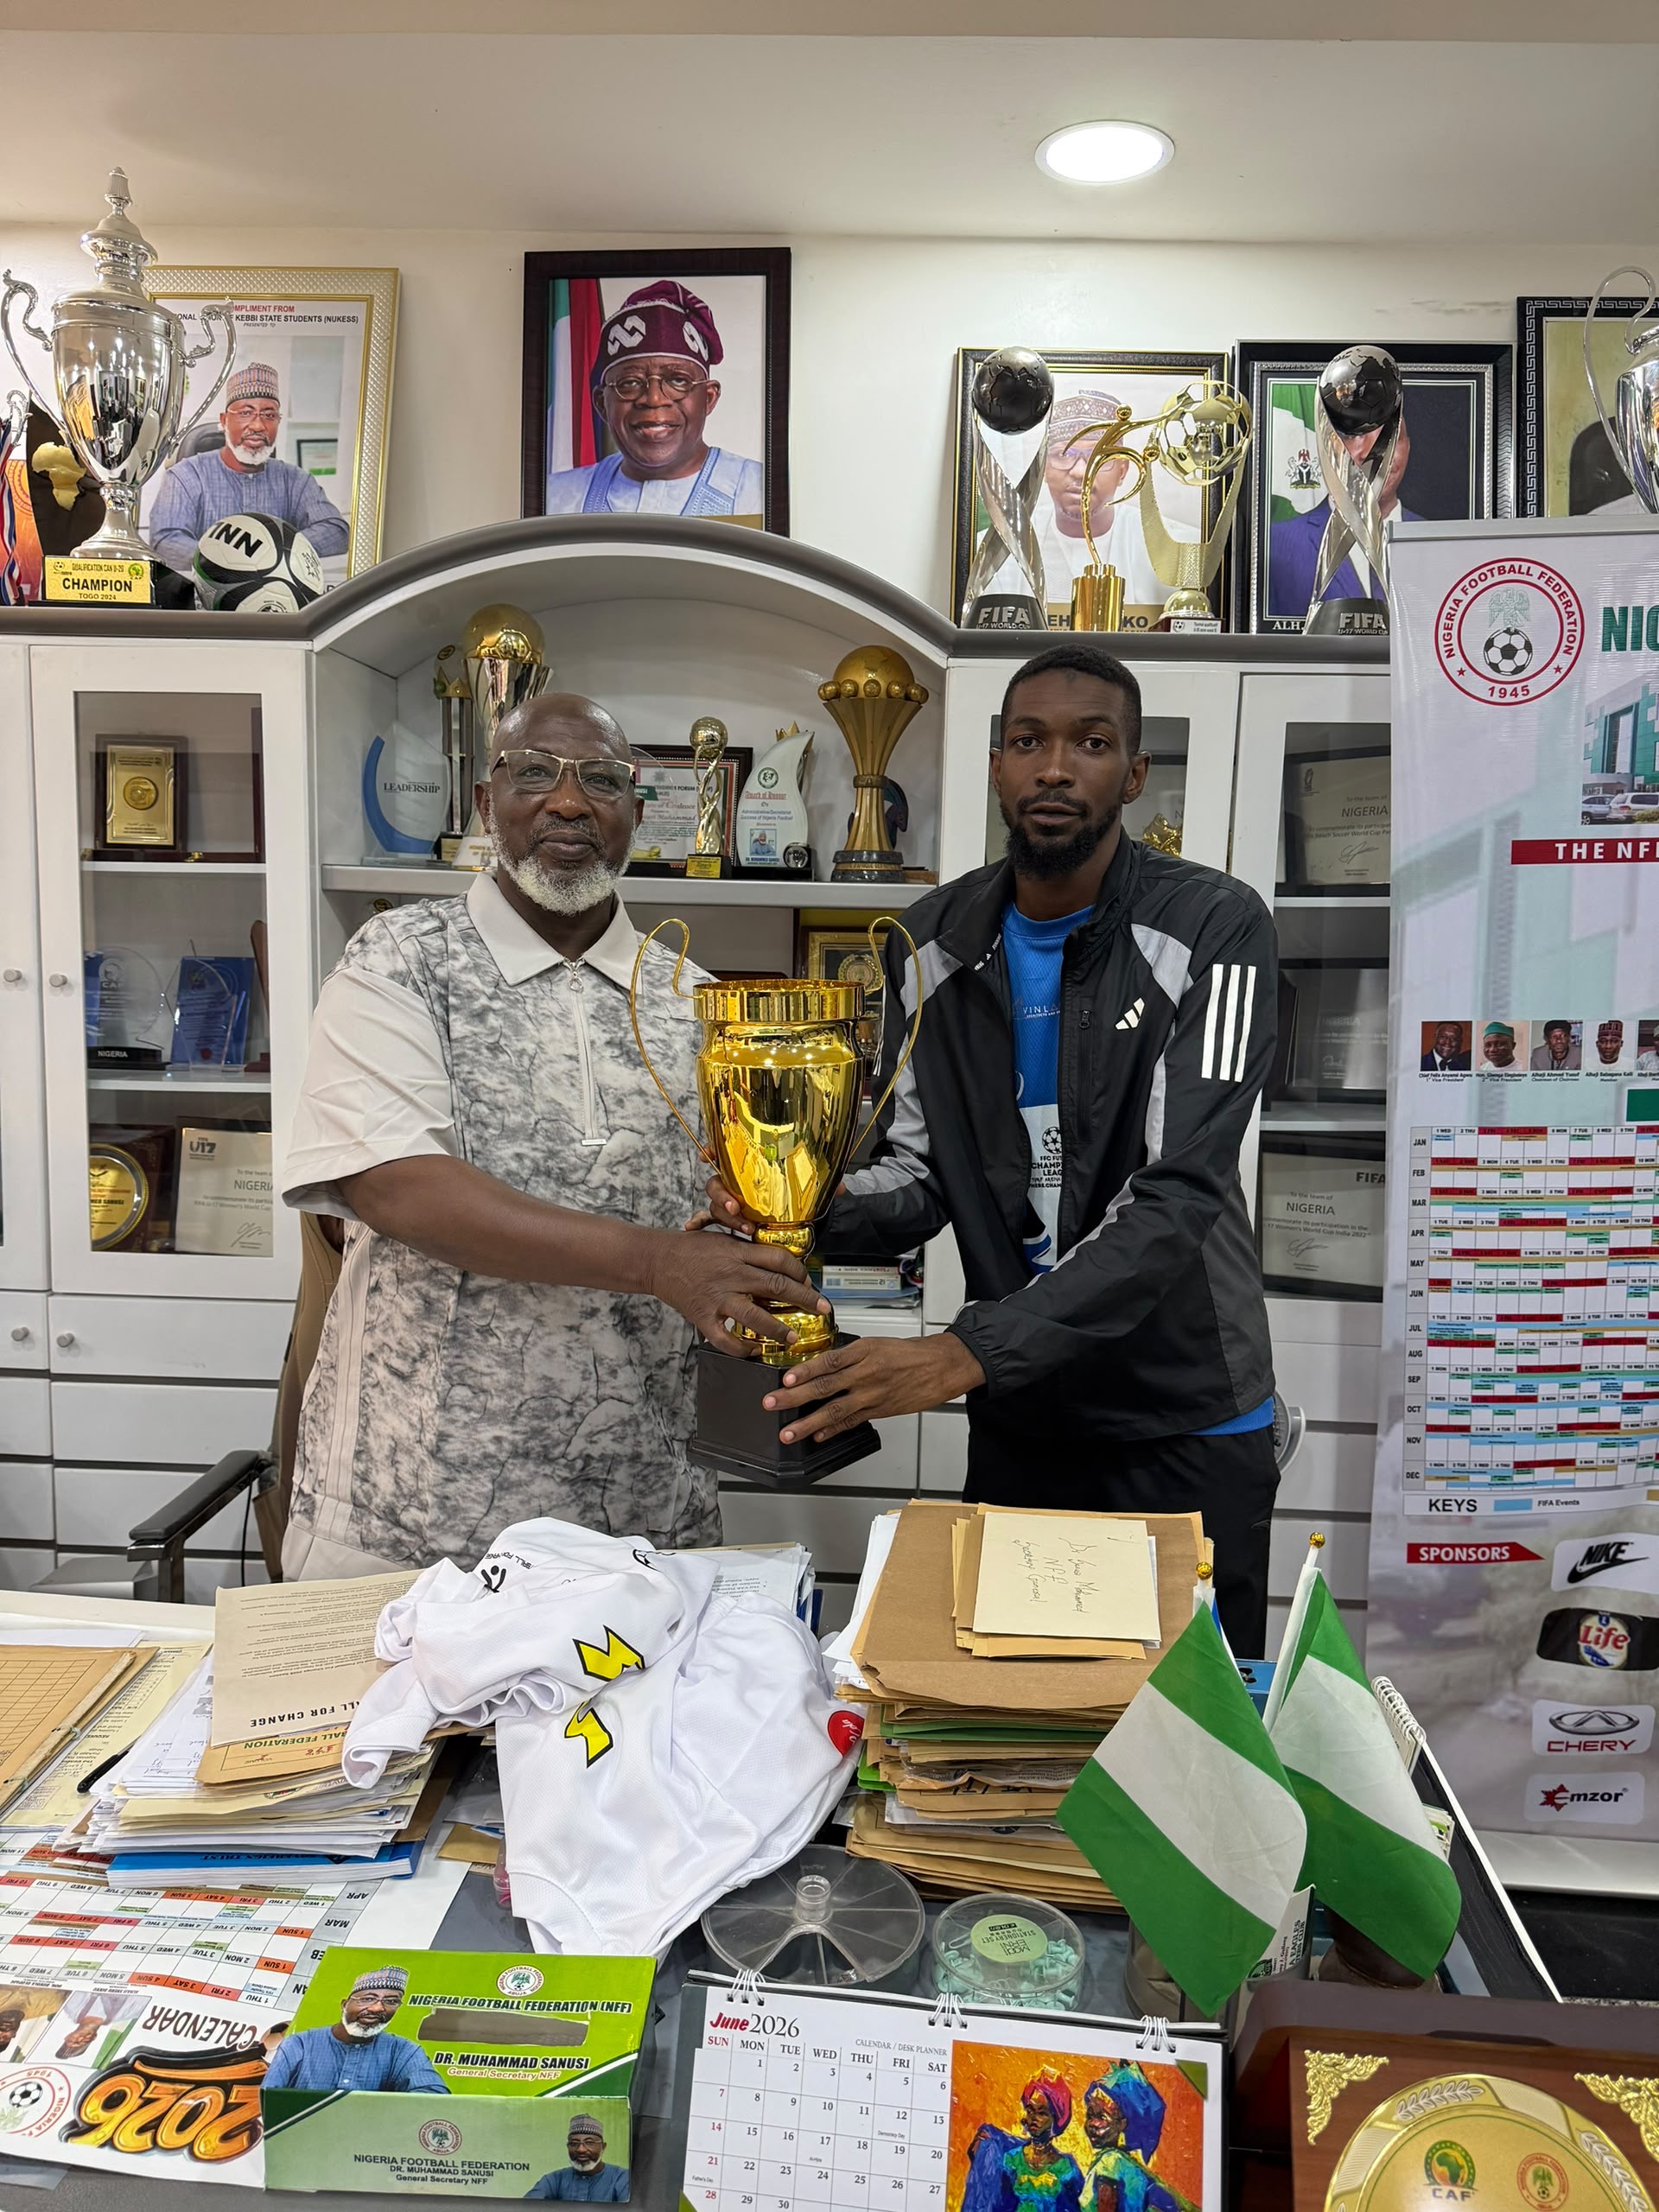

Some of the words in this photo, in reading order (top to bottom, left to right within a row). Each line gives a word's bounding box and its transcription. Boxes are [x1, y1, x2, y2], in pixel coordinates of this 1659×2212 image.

[324, 315, 358, 324] (NUKESS)
[104, 563, 112, 572] CAN
[63, 578, 132, 592] CHAMPION
[978, 607, 1029, 624] FIFA
[1442, 598, 1463, 659] NIGERIA
[1460, 564, 1533, 595] FOOTBALL
[1537, 571, 1578, 656] FEDERATION
[1273, 621, 1304, 630] ALH.
[1340, 613, 1386, 629] FIFA
[1488, 685, 1530, 698] 1945
[384, 782, 440, 793] LEADERSHIP
[1341, 805, 1388, 817] NIGERIA
[1555, 842, 1605, 860] THE
[1617, 842, 1659, 859] NF
[189, 1141, 216, 1154] U17
[1286, 1202, 1335, 1215] NIGERIA
[1428, 1499, 1478, 1512] KEYS
[1419, 1546, 1510, 1562] SPONSORS
[1580, 1541, 1630, 1566] NIKE
[1579, 1625, 1629, 1650] Life
[310, 1706, 335, 1717] FOR
[251, 1712, 304, 1727] CHANGE
[244, 1736, 318, 1749] FEDERATION
[1547, 1739, 1637, 1752] CHERY
[325, 1918, 351, 1928] MAR
[995, 1929, 1036, 1941] STATIONERY
[1289, 1920, 1300, 1957] EAGLES
[225, 1954, 243, 1962] MON
[174, 1980, 188, 1988] SAT
[409, 1994, 461, 2006] NIGERIA
[461, 1997, 521, 2010] FOOTBALL
[524, 1999, 598, 2012] FEDERATION
[600, 2001, 632, 2013] (NFF)
[142, 2005, 259, 2051] CALENDAR
[709, 2012, 749, 2031] June
[749, 2013, 800, 2037] 2026
[708, 2036, 729, 2046] SUN
[740, 2040, 765, 2051] MON
[780, 2044, 801, 2055] TUE
[813, 2048, 837, 2060] WED
[851, 2053, 874, 2064] THU
[893, 2058, 910, 2069] FRI
[927, 2063, 947, 2073] SAT
[855, 2038, 892, 2050] CALENDAR
[898, 2044, 915, 2052] DESK
[916, 2045, 947, 2056] PLANNER
[434, 2052, 454, 2065] DR.
[459, 2053, 537, 2069] MUHAMMAD
[540, 2057, 589, 2069] SANUSI
[448, 2068, 487, 2077] General
[489, 2069, 537, 2081] Secretary
[538, 2071, 561, 2080] NFF
[757, 2059, 762, 2068] 1
[793, 2063, 799, 2072] 2
[866, 2072, 873, 2081] 4
[904, 2077, 909, 2086] 5
[940, 2081, 946, 2089] 6
[719, 2088, 724, 2097] 7
[755, 2093, 760, 2101] 8
[791, 2097, 797, 2106] 9
[823, 2102, 833, 2111] 10
[859, 2107, 869, 2115] 11
[896, 2111, 907, 2120] 12
[933, 2115, 944, 2124] 13
[36, 2096, 66, 2135] NIGERIA
[67, 2074, 262, 2161] 2026
[711, 2122, 721, 2131] 14
[747, 2127, 758, 2136] 15
[784, 2132, 794, 2140] 16
[820, 2136, 831, 2145] 17
[857, 2141, 868, 2150] 18
[894, 2145, 906, 2155] 19
[931, 2150, 943, 2159] 20
[354, 2154, 397, 2164] NIGERIA
[401, 2158, 458, 2169] FOOTBALL
[461, 2160, 530, 2171] FEDERATION
[407, 2167, 459, 2176] MUHAMMAD
[708, 2157, 718, 2165] 21
[744, 2161, 755, 2171] 22
[780, 2166, 791, 2175] 23
[817, 2171, 829, 2180] 24
[855, 2175, 866, 2184] 25
[892, 2180, 904, 2190] 26
[929, 2184, 941, 2194] 27
[396, 2174, 428, 2183] General
[429, 2176, 469, 2185] Secretary
[705, 2190, 717, 2199] 28
[741, 2195, 753, 2204] 29
[778, 2200, 790, 2209] 30
[1432, 2188, 1471, 2202] CAF
